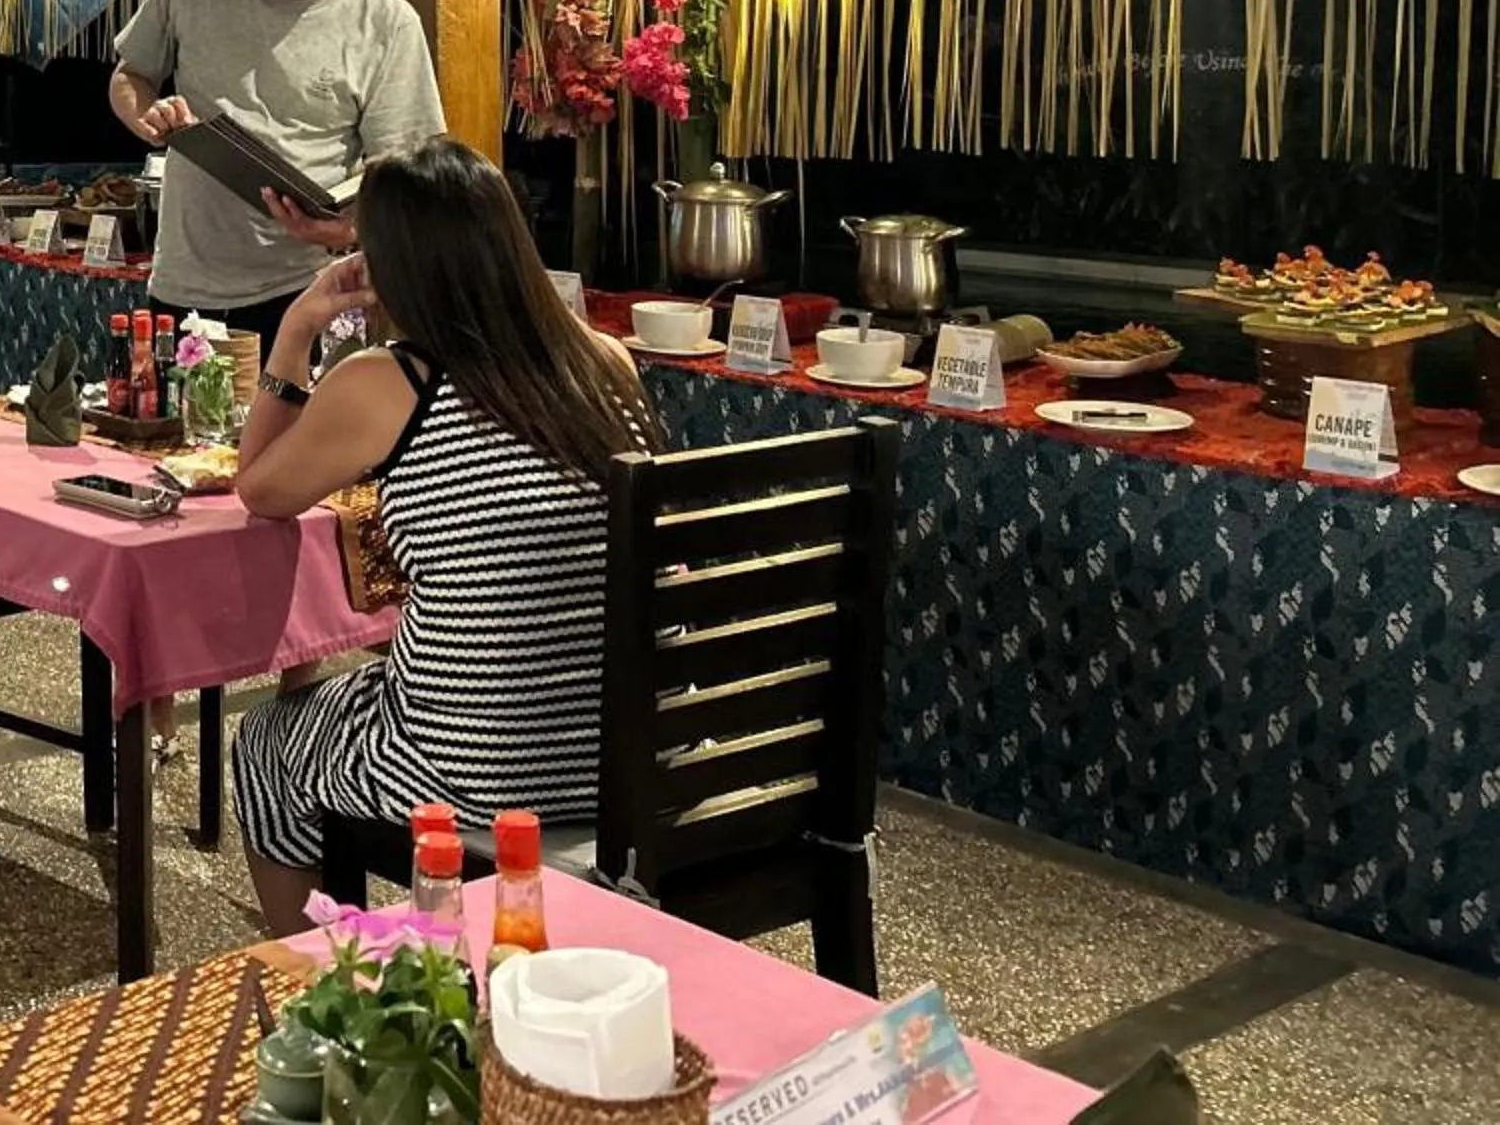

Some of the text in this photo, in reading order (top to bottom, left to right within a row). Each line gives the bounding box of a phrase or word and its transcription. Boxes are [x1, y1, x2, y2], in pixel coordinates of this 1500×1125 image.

[938, 355, 988, 378] VEGETABLE
[938, 373, 980, 395] TEMPURA
[1314, 413, 1373, 438] CANAPE
[715, 1074, 809, 1125] SERVED
